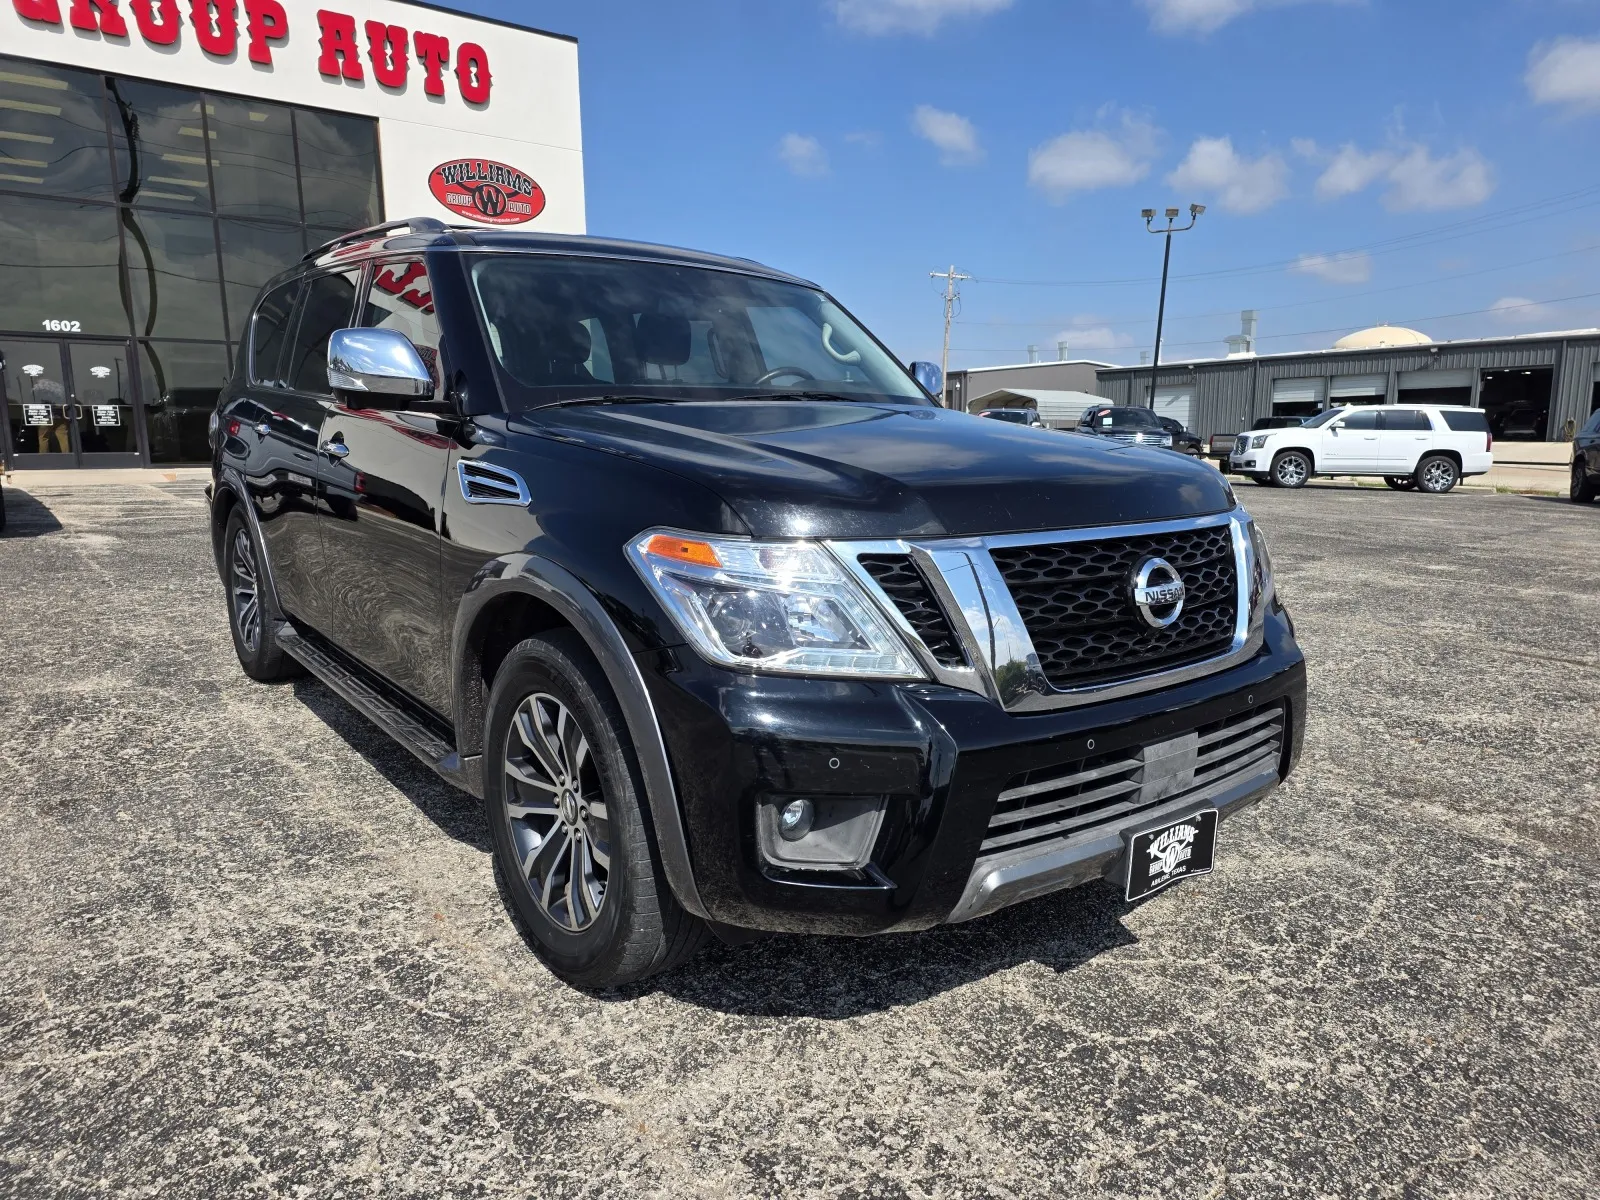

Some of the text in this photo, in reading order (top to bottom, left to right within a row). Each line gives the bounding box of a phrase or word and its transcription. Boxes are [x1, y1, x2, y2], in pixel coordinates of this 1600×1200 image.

[11, 0, 493, 104] OUP AUTO
[441, 162, 532, 196] WILLIAMS
[446, 193, 532, 214] GROUP AUTO
[42, 319, 81, 332] 1602
[1145, 586, 1184, 601] NISSAN
[1149, 825, 1195, 859] WILLIAMS
